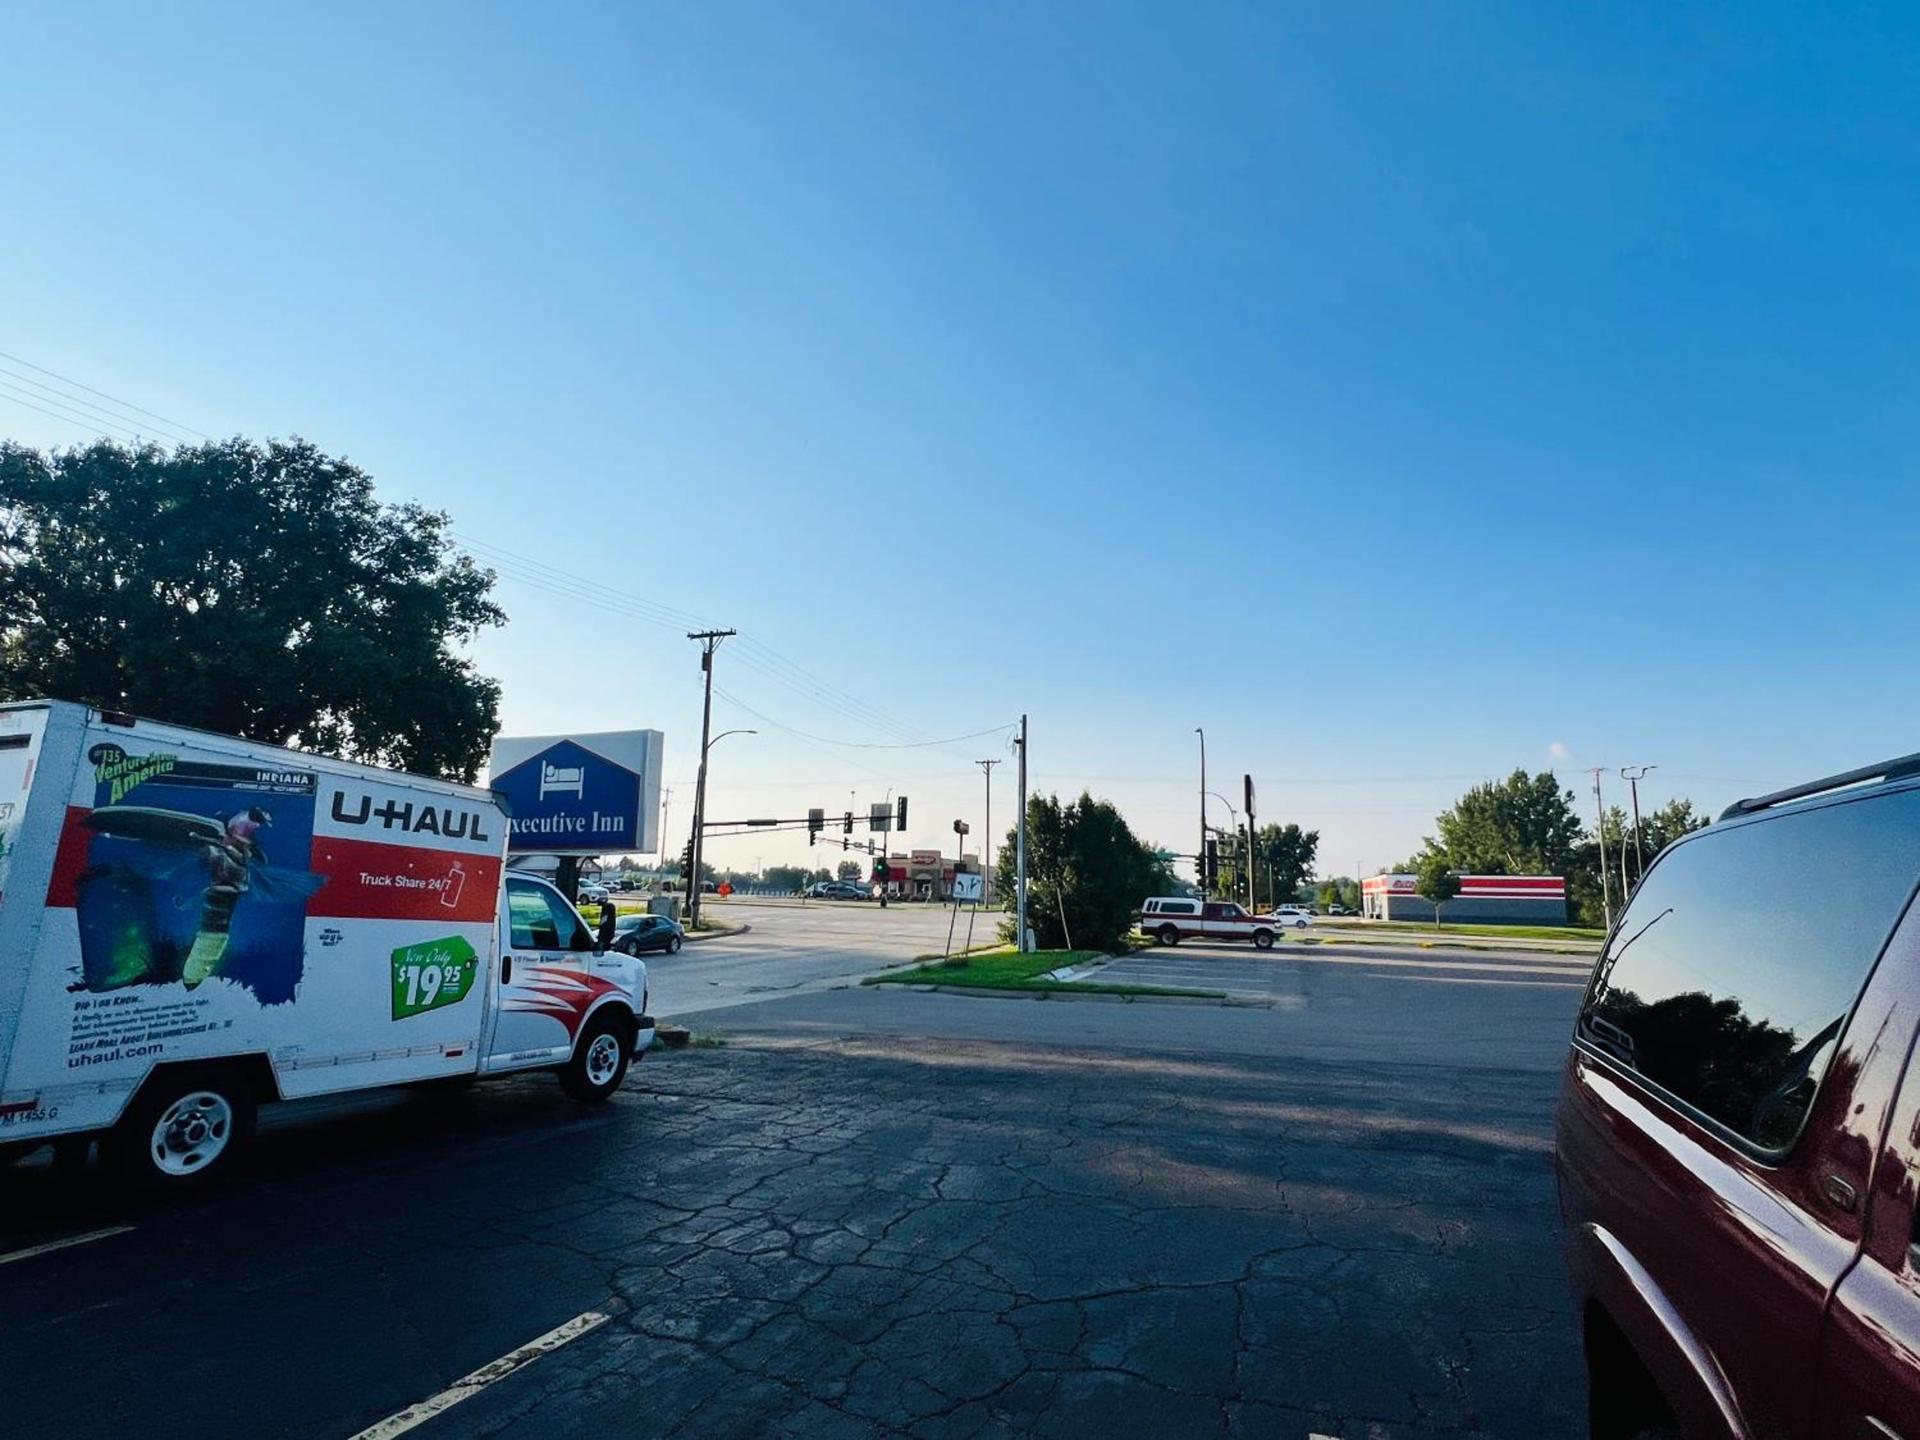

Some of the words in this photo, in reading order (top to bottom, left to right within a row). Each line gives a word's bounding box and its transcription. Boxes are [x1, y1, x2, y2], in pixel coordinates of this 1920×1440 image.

[110, 760, 174, 805] America
[256, 771, 309, 785] INDIANA
[510, 811, 587, 833] xecutive
[591, 811, 625, 832] Inn
[359, 872, 392, 886] Truck
[395, 875, 426, 889] Share
[427, 878, 452, 891] 24/7
[68, 1044, 164, 1068] uhaul.com
